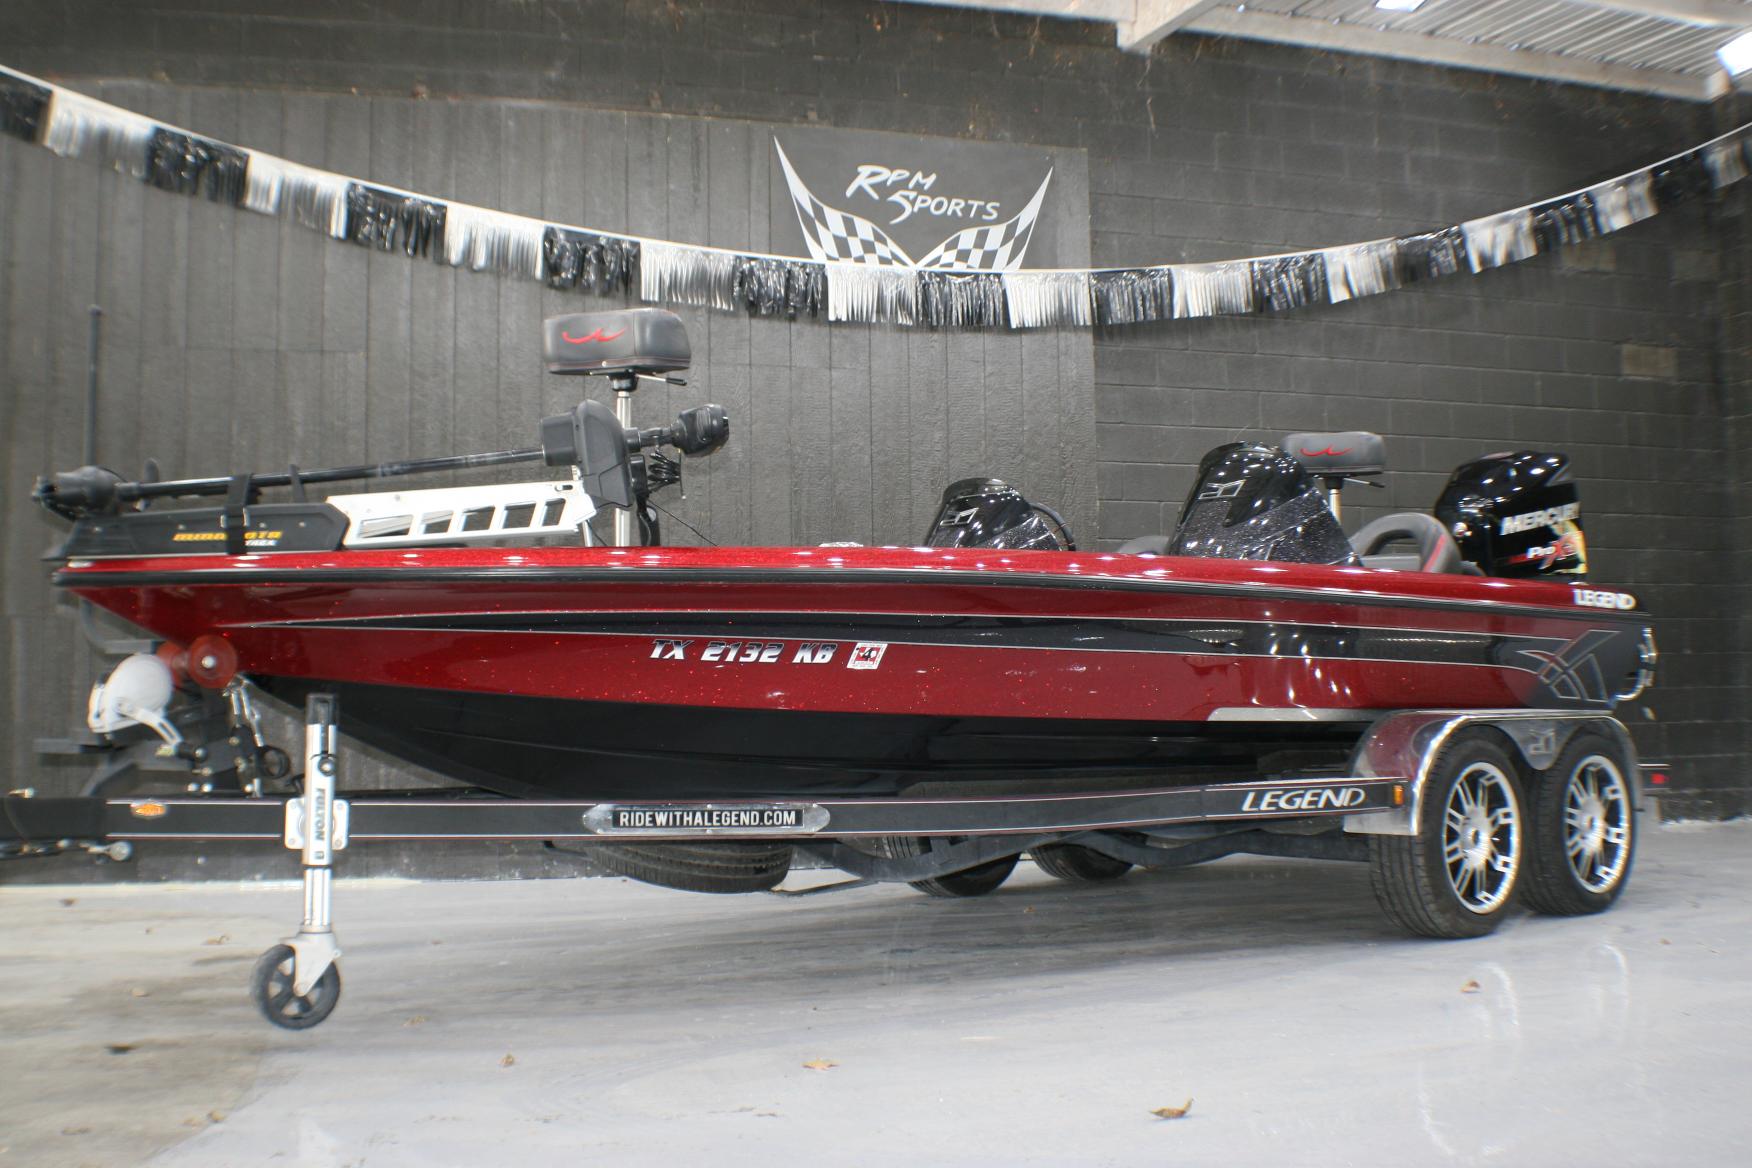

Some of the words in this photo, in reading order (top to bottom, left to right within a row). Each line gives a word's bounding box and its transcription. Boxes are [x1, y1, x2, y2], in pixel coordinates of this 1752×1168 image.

[846, 164, 936, 200] RPM
[887, 190, 1000, 225] SPORTS
[1573, 588, 1636, 610] LEGEND
[650, 639, 694, 660] TX
[700, 641, 784, 663] 2132
[792, 642, 838, 664] KB
[1241, 787, 1366, 812] LEGEND
[314, 787, 327, 842] FULTON
[619, 810, 796, 827] RIDEWITHALEGEND.COM
